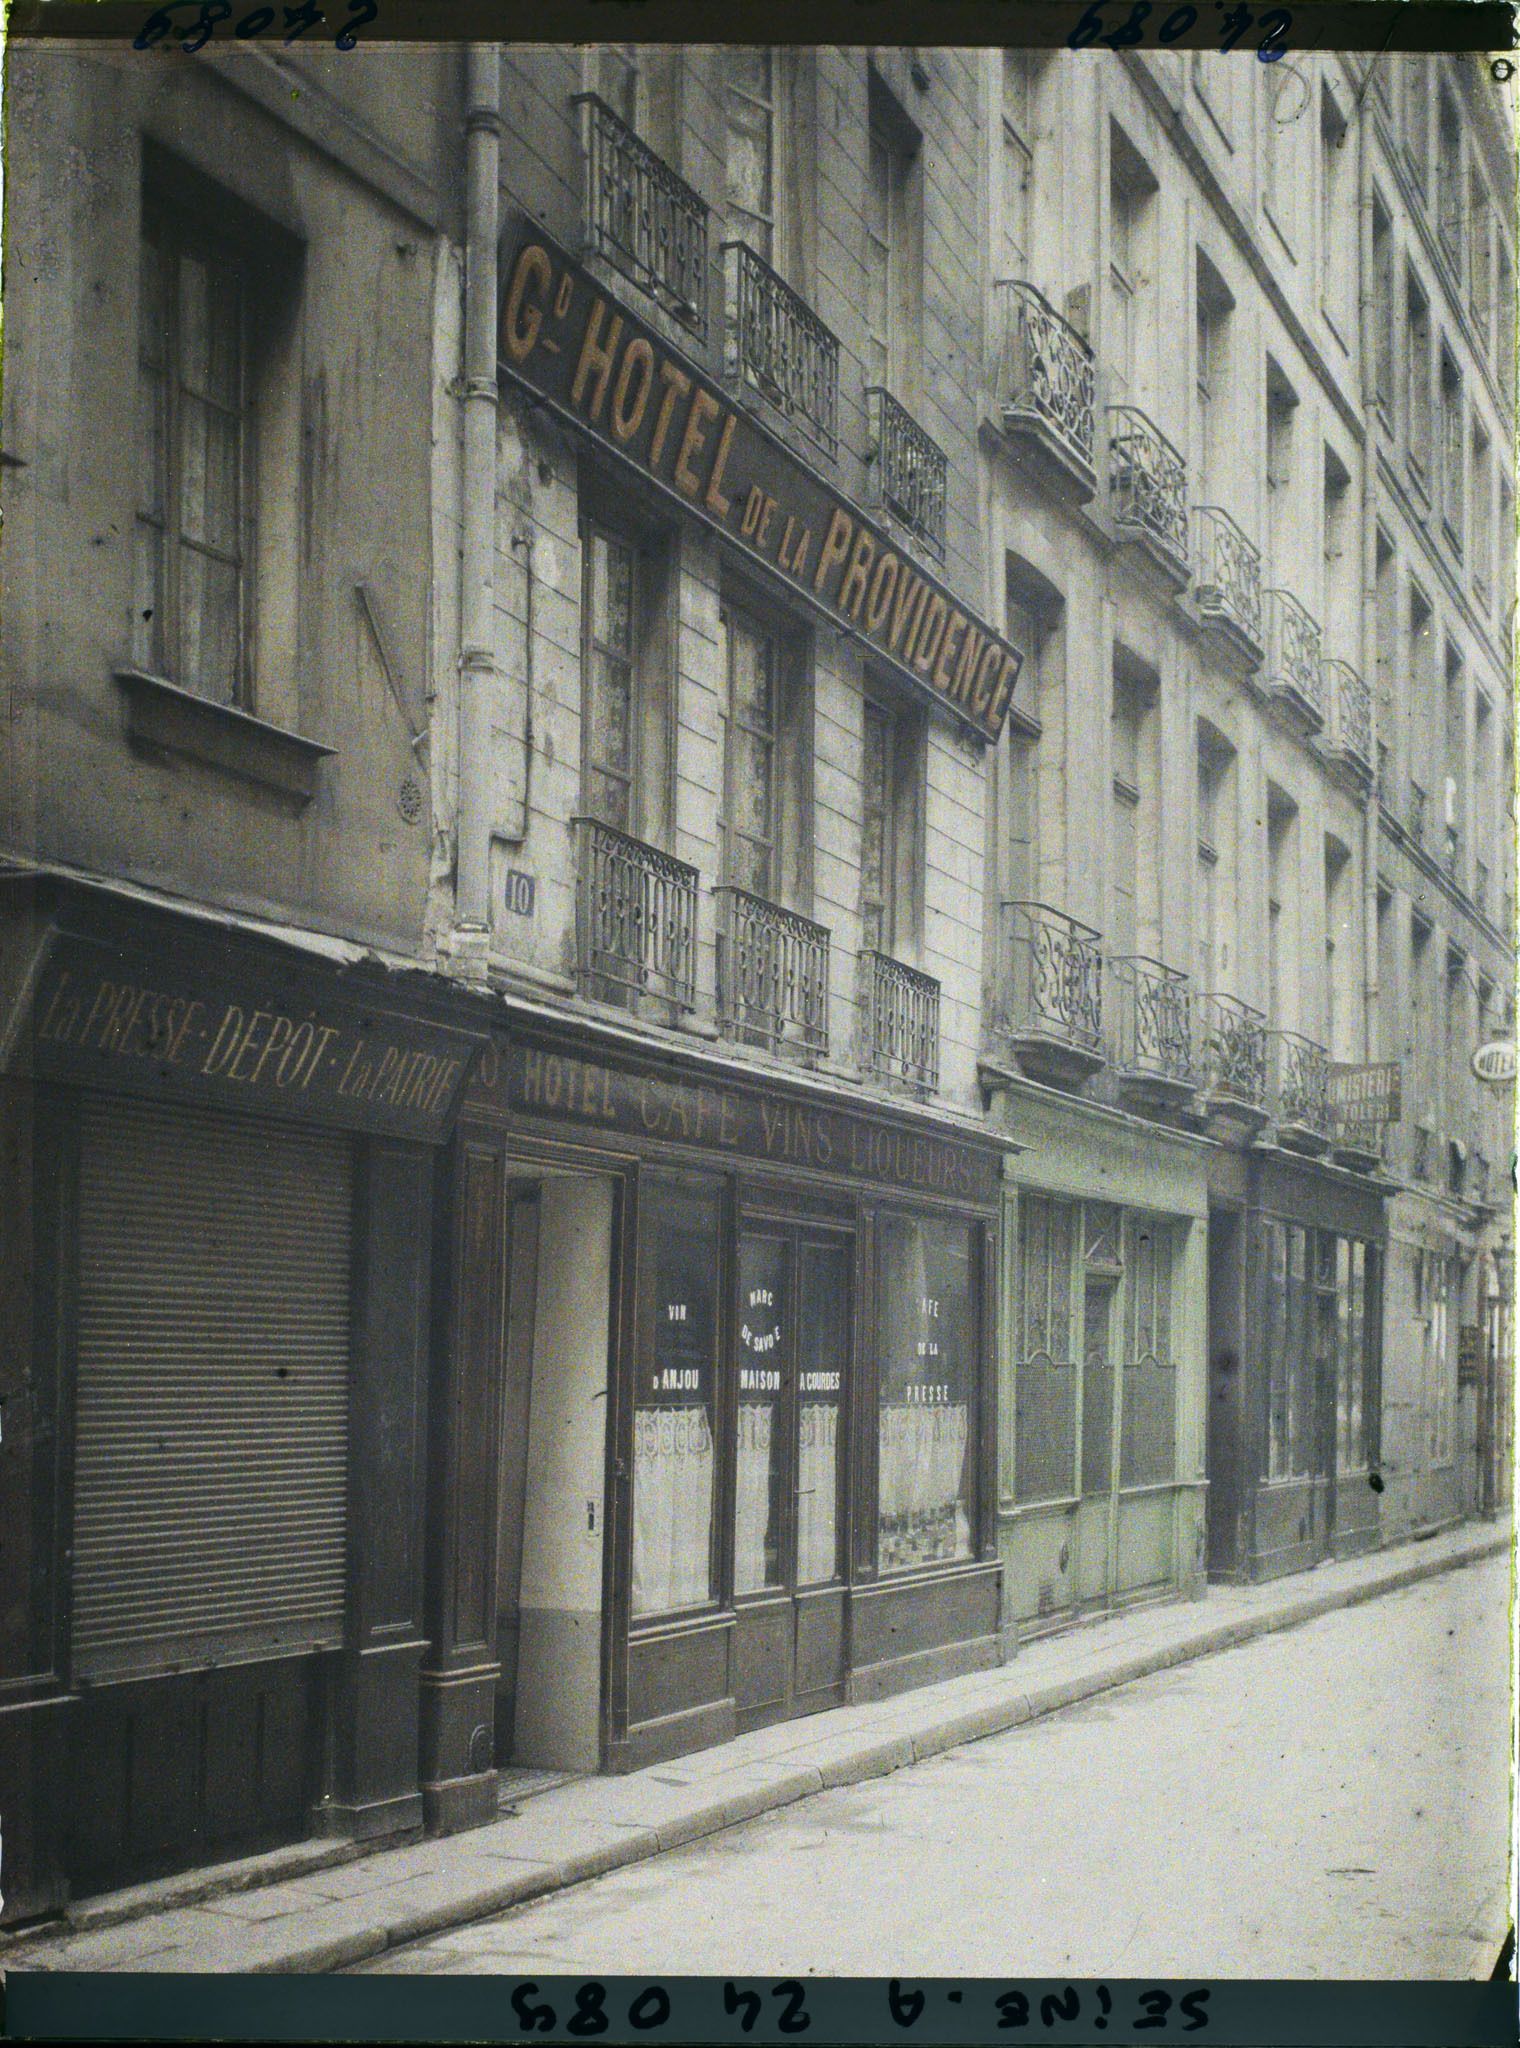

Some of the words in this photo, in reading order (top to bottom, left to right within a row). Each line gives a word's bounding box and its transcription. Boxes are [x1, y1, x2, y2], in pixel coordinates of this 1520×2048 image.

[571, 299, 737, 519] HOTEL
[741, 484, 778, 547] DE
[778, 515, 811, 576] LA
[814, 508, 1019, 729] PROVIDENCE
[510, 874, 530, 915] 10
[79, 980, 205, 1064] PRESSE
[366, 1045, 459, 1114] PATRIE
[760, 1096, 832, 1164] VINS
[849, 1122, 972, 1195] LIQUEURS
[750, 1289, 773, 1308] MARC
[669, 1305, 686, 1321] VIN
[741, 1324, 753, 1346] DE
[929, 1343, 938, 1356] LA
[741, 1369, 780, 1390] MAISON
[906, 1385, 948, 1402] PRESSE
